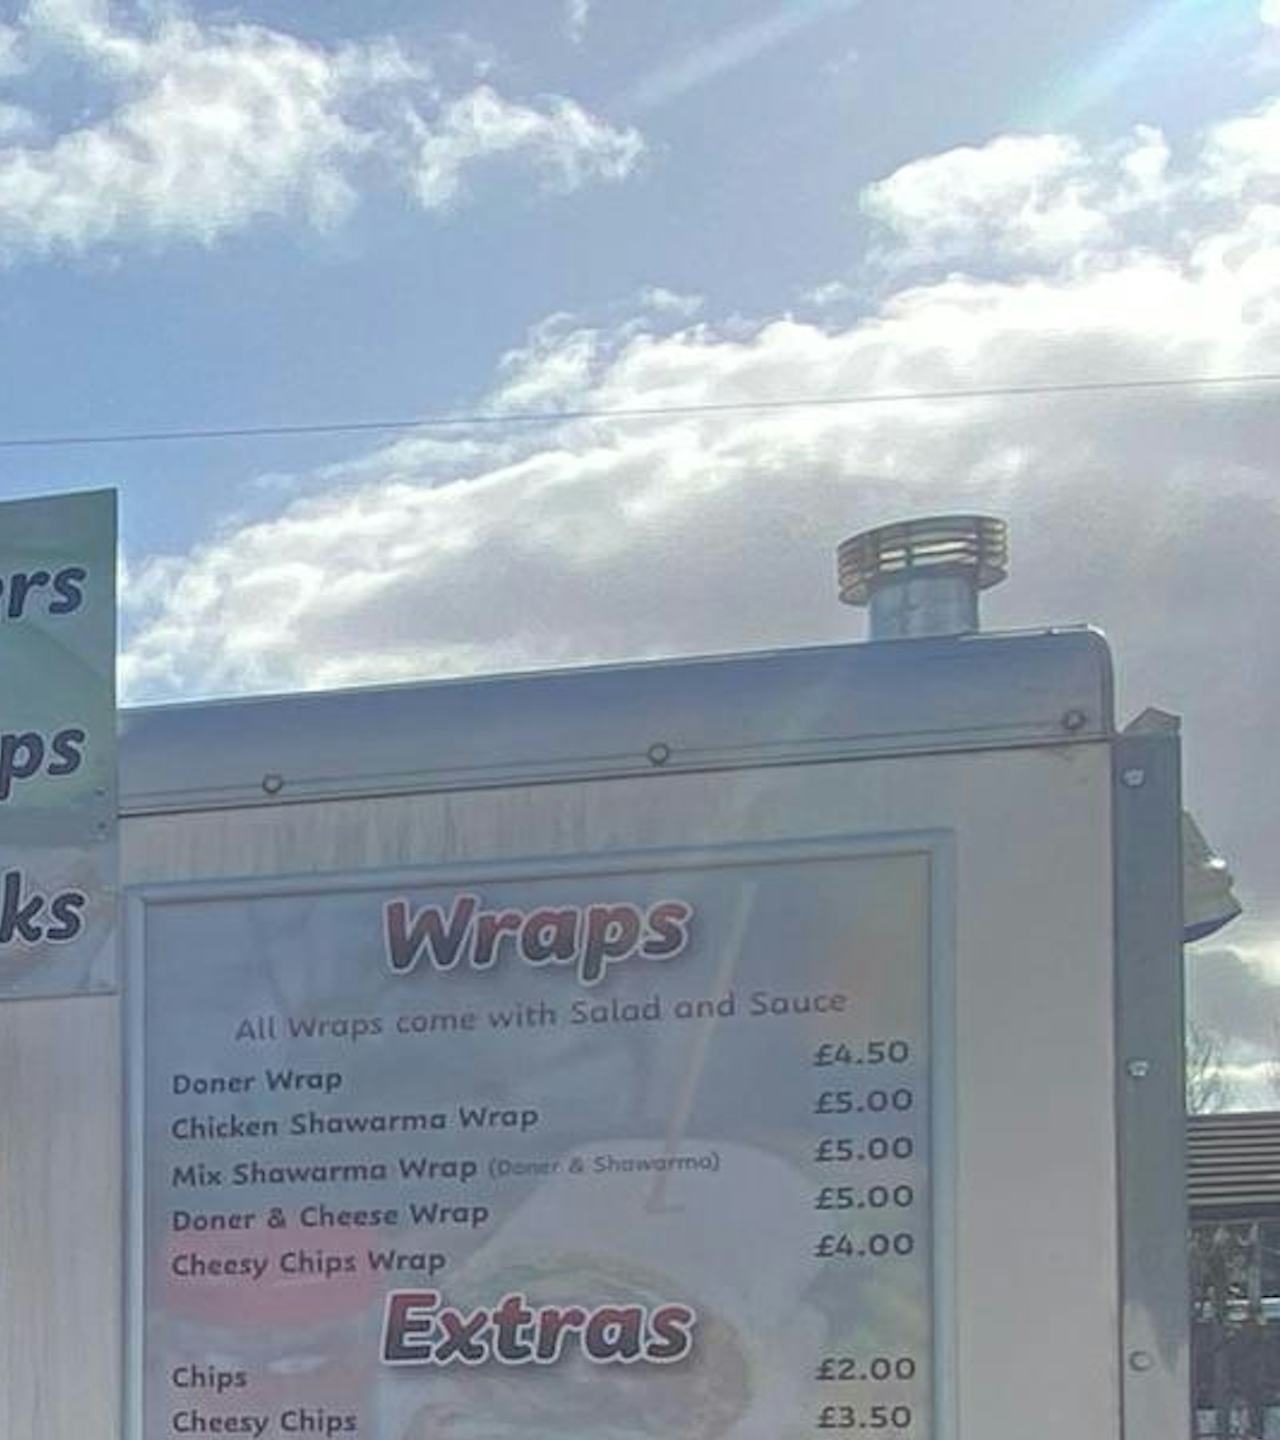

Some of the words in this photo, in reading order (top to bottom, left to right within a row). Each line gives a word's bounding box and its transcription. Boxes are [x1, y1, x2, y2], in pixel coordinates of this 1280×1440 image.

[382, 890, 698, 981] Wraps
[236, 1016, 277, 1039] All
[287, 1013, 382, 1041] Wraps
[396, 1007, 475, 1032] come
[488, 1001, 557, 1027] with
[570, 996, 662, 1022] Salad
[674, 993, 736, 1016] and
[749, 988, 847, 1013] Sauce
[814, 1040, 908, 1064] £4.50
[172, 1072, 254, 1092] Doner
[265, 1068, 342, 1096] Wrap
[814, 1089, 913, 1111] £5.00
[172, 1114, 279, 1137] Chicken
[289, 1109, 448, 1133] Shawarma
[459, 1104, 538, 1131] Wrap
[814, 1136, 914, 1160] £5.00
[172, 1163, 222, 1184] Mix
[233, 1157, 387, 1182] Shawarma
[398, 1155, 478, 1182] Wrap
[814, 1184, 914, 1208] £5.00
[172, 1208, 256, 1229] Doner
[267, 1205, 287, 1225] &
[299, 1203, 399, 1225] Cheese
[410, 1200, 489, 1227] Wrap
[814, 1232, 914, 1255] £4.00
[172, 1250, 268, 1274] Cheesy
[280, 1249, 357, 1274] Chips
[368, 1248, 446, 1273] Wrap
[382, 1288, 697, 1361] Extras
[172, 1366, 247, 1392] Chips
[815, 1356, 916, 1379] £2.00
[172, 1410, 268, 1435] Cheesy
[280, 1408, 357, 1434] Chips
[818, 1405, 912, 1428] £3.50
